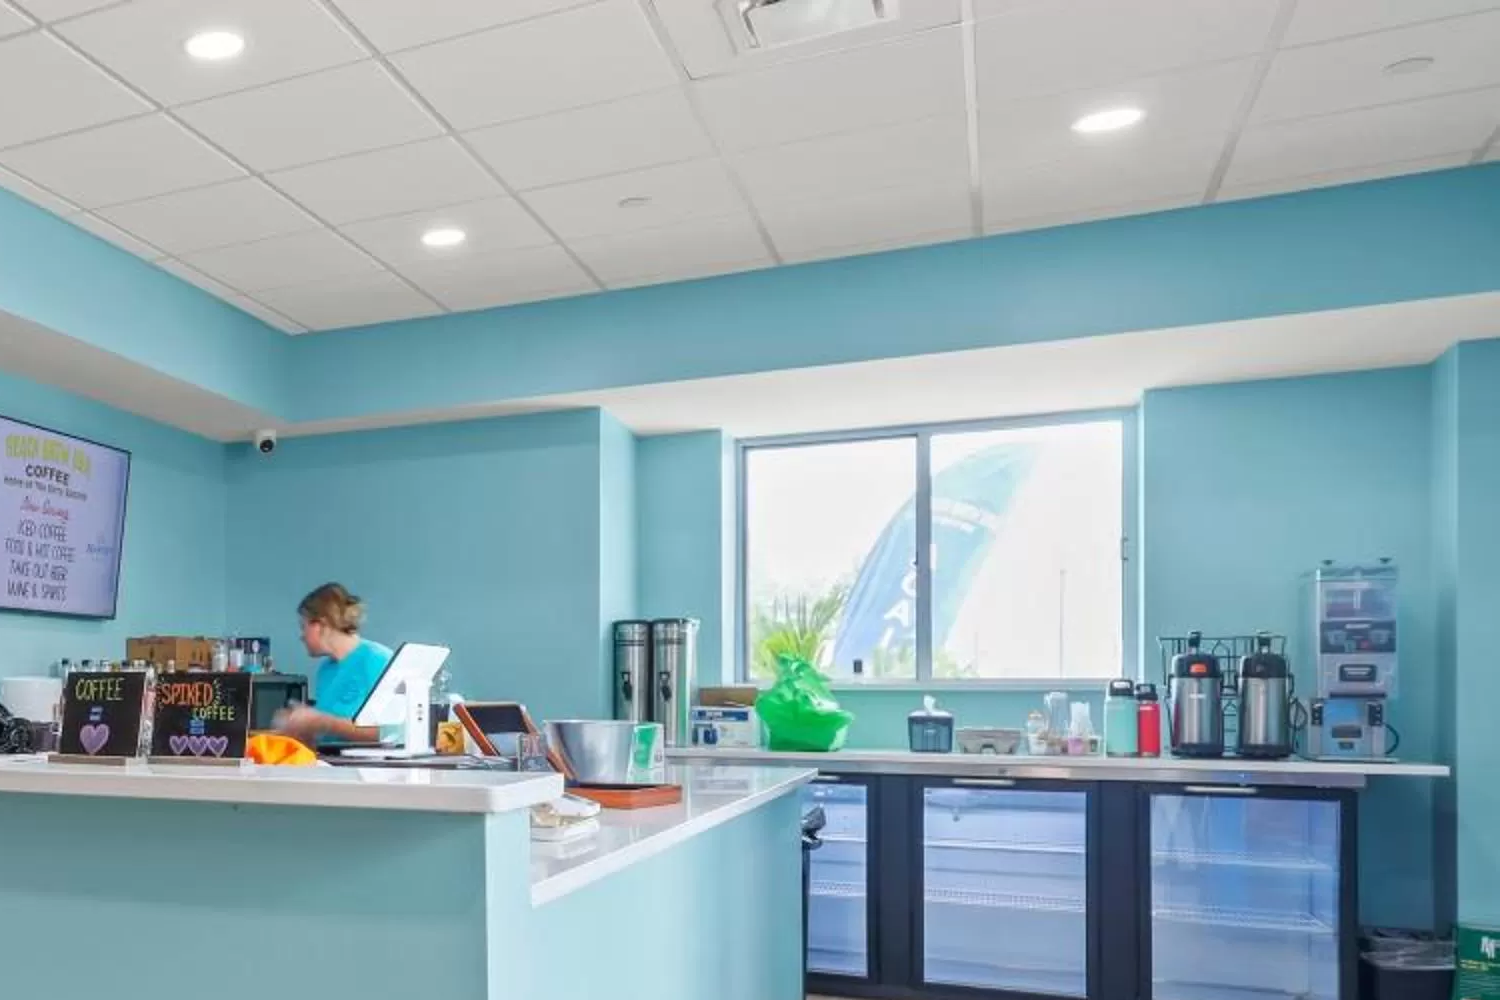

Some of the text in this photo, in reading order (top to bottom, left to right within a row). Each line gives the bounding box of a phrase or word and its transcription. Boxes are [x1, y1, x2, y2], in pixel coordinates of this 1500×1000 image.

[25, 464, 70, 486] COFFEE
[38, 522, 67, 543] COFFEE
[51, 545, 76, 563] COFFEE
[10, 559, 31, 577] TAKE
[33, 563, 49, 579] OUT
[7, 579, 30, 600] WINE
[75, 677, 125, 700] COFFEE
[161, 681, 213, 706] SPIKED
[193, 704, 235, 721] COFFEE
